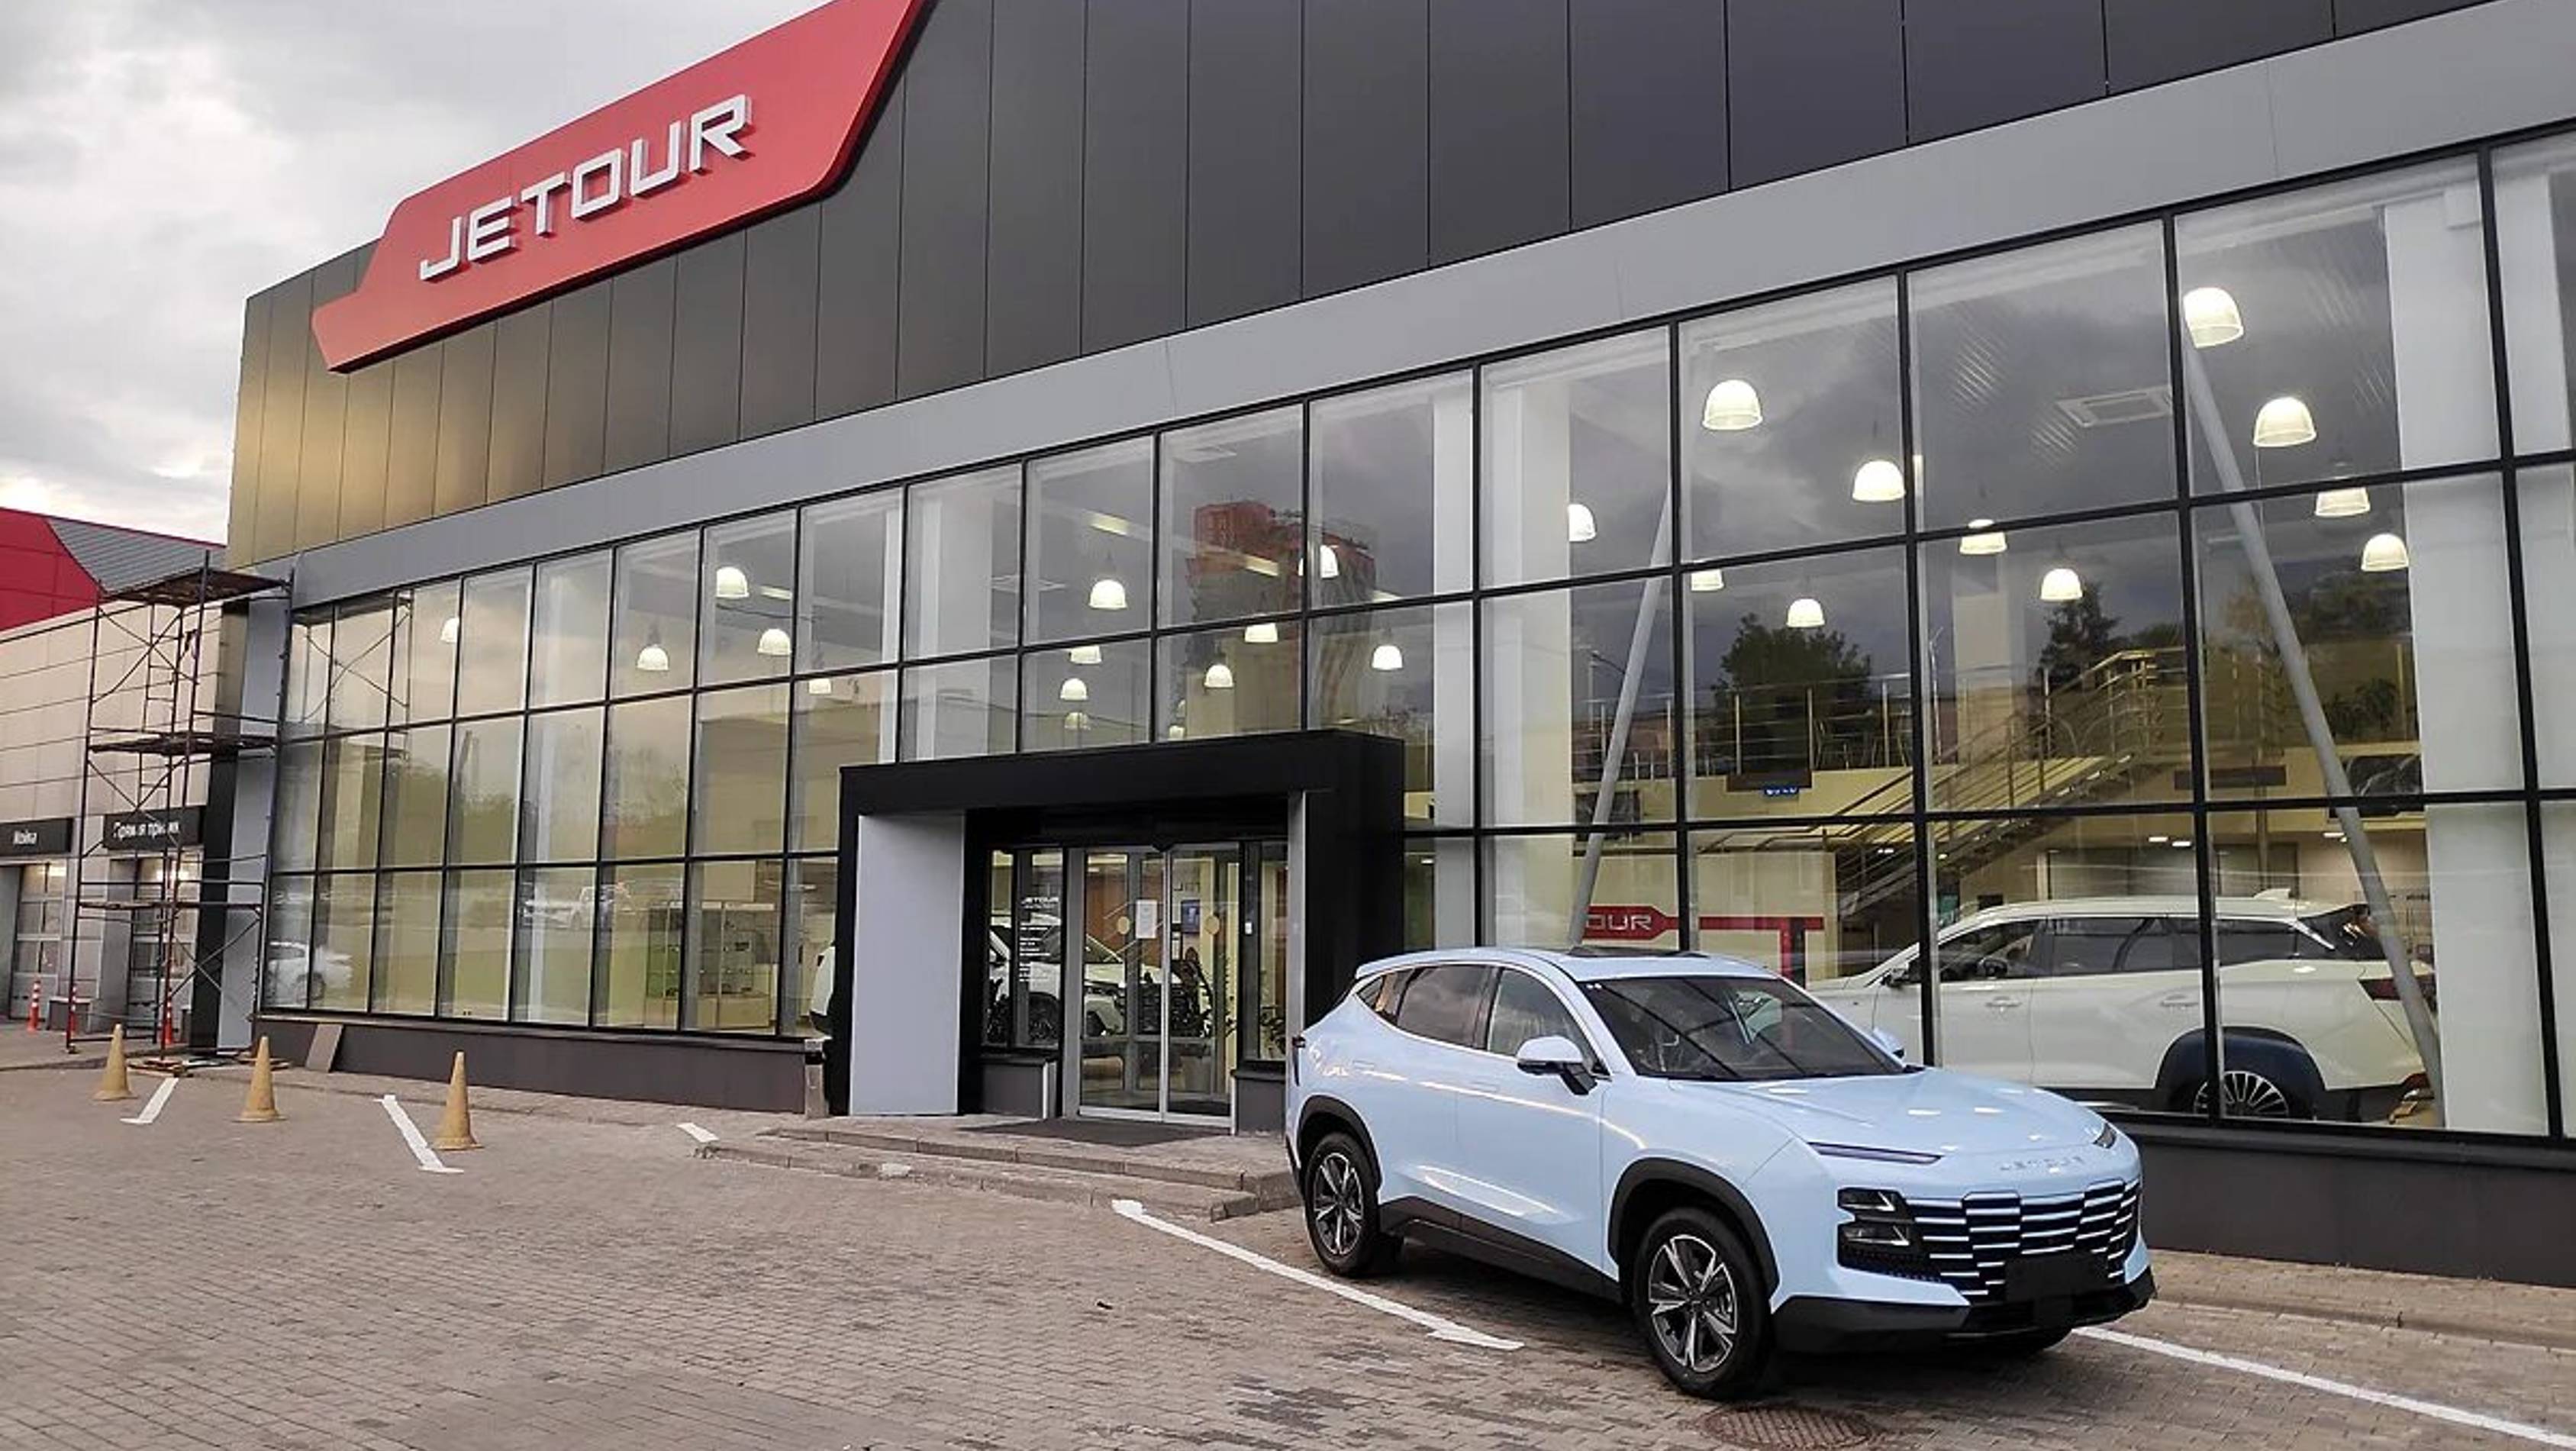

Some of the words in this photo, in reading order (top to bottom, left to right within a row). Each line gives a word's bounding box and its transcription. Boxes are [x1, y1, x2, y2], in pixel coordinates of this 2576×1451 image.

[420, 94, 752, 282] JETOUR
[113, 821, 146, 841] Прямя
[1586, 914, 1652, 930] OUR
